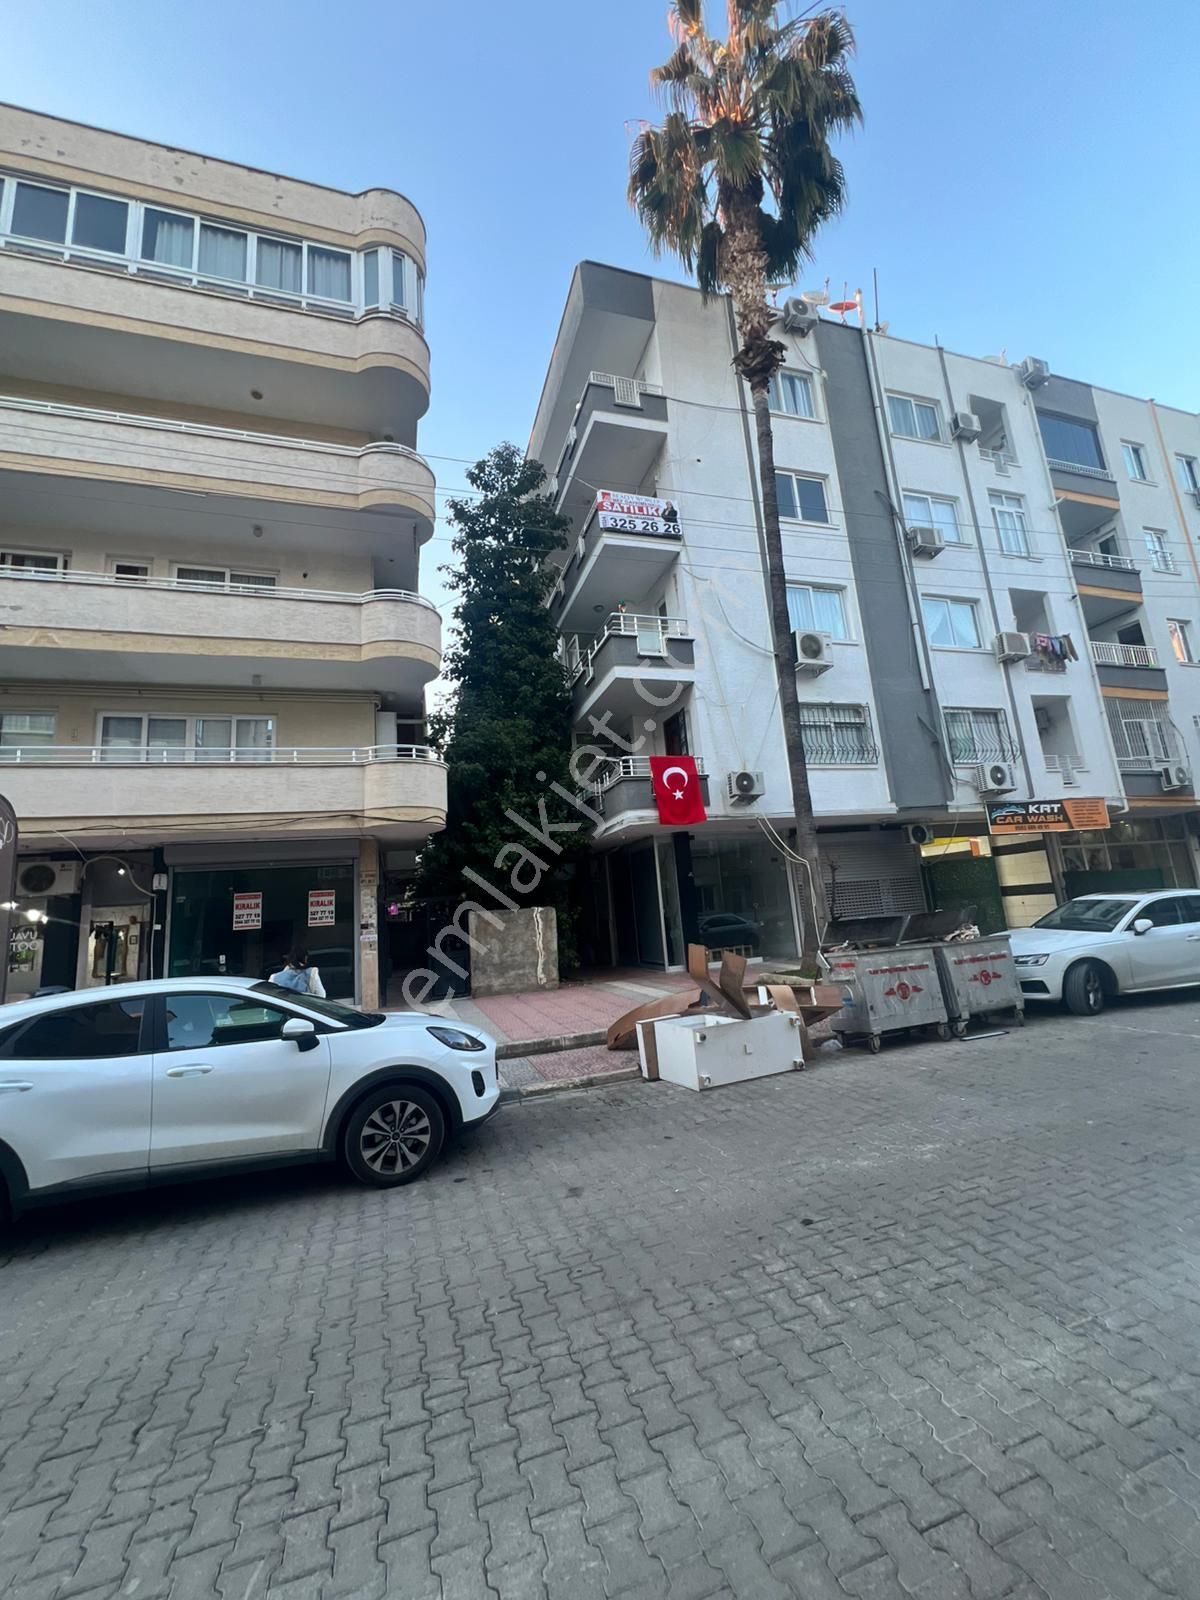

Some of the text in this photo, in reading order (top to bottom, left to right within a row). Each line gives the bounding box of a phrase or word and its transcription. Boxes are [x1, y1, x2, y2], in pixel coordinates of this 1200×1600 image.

[602, 501, 658, 516] SATILIK
[609, 517, 637, 530] 325
[641, 521, 659, 532] 26
[663, 523, 681, 534] 26
[1028, 803, 1061, 814] KRT
[996, 814, 1064, 824] CAR WASH
[235, 902, 260, 910] KIRALIK
